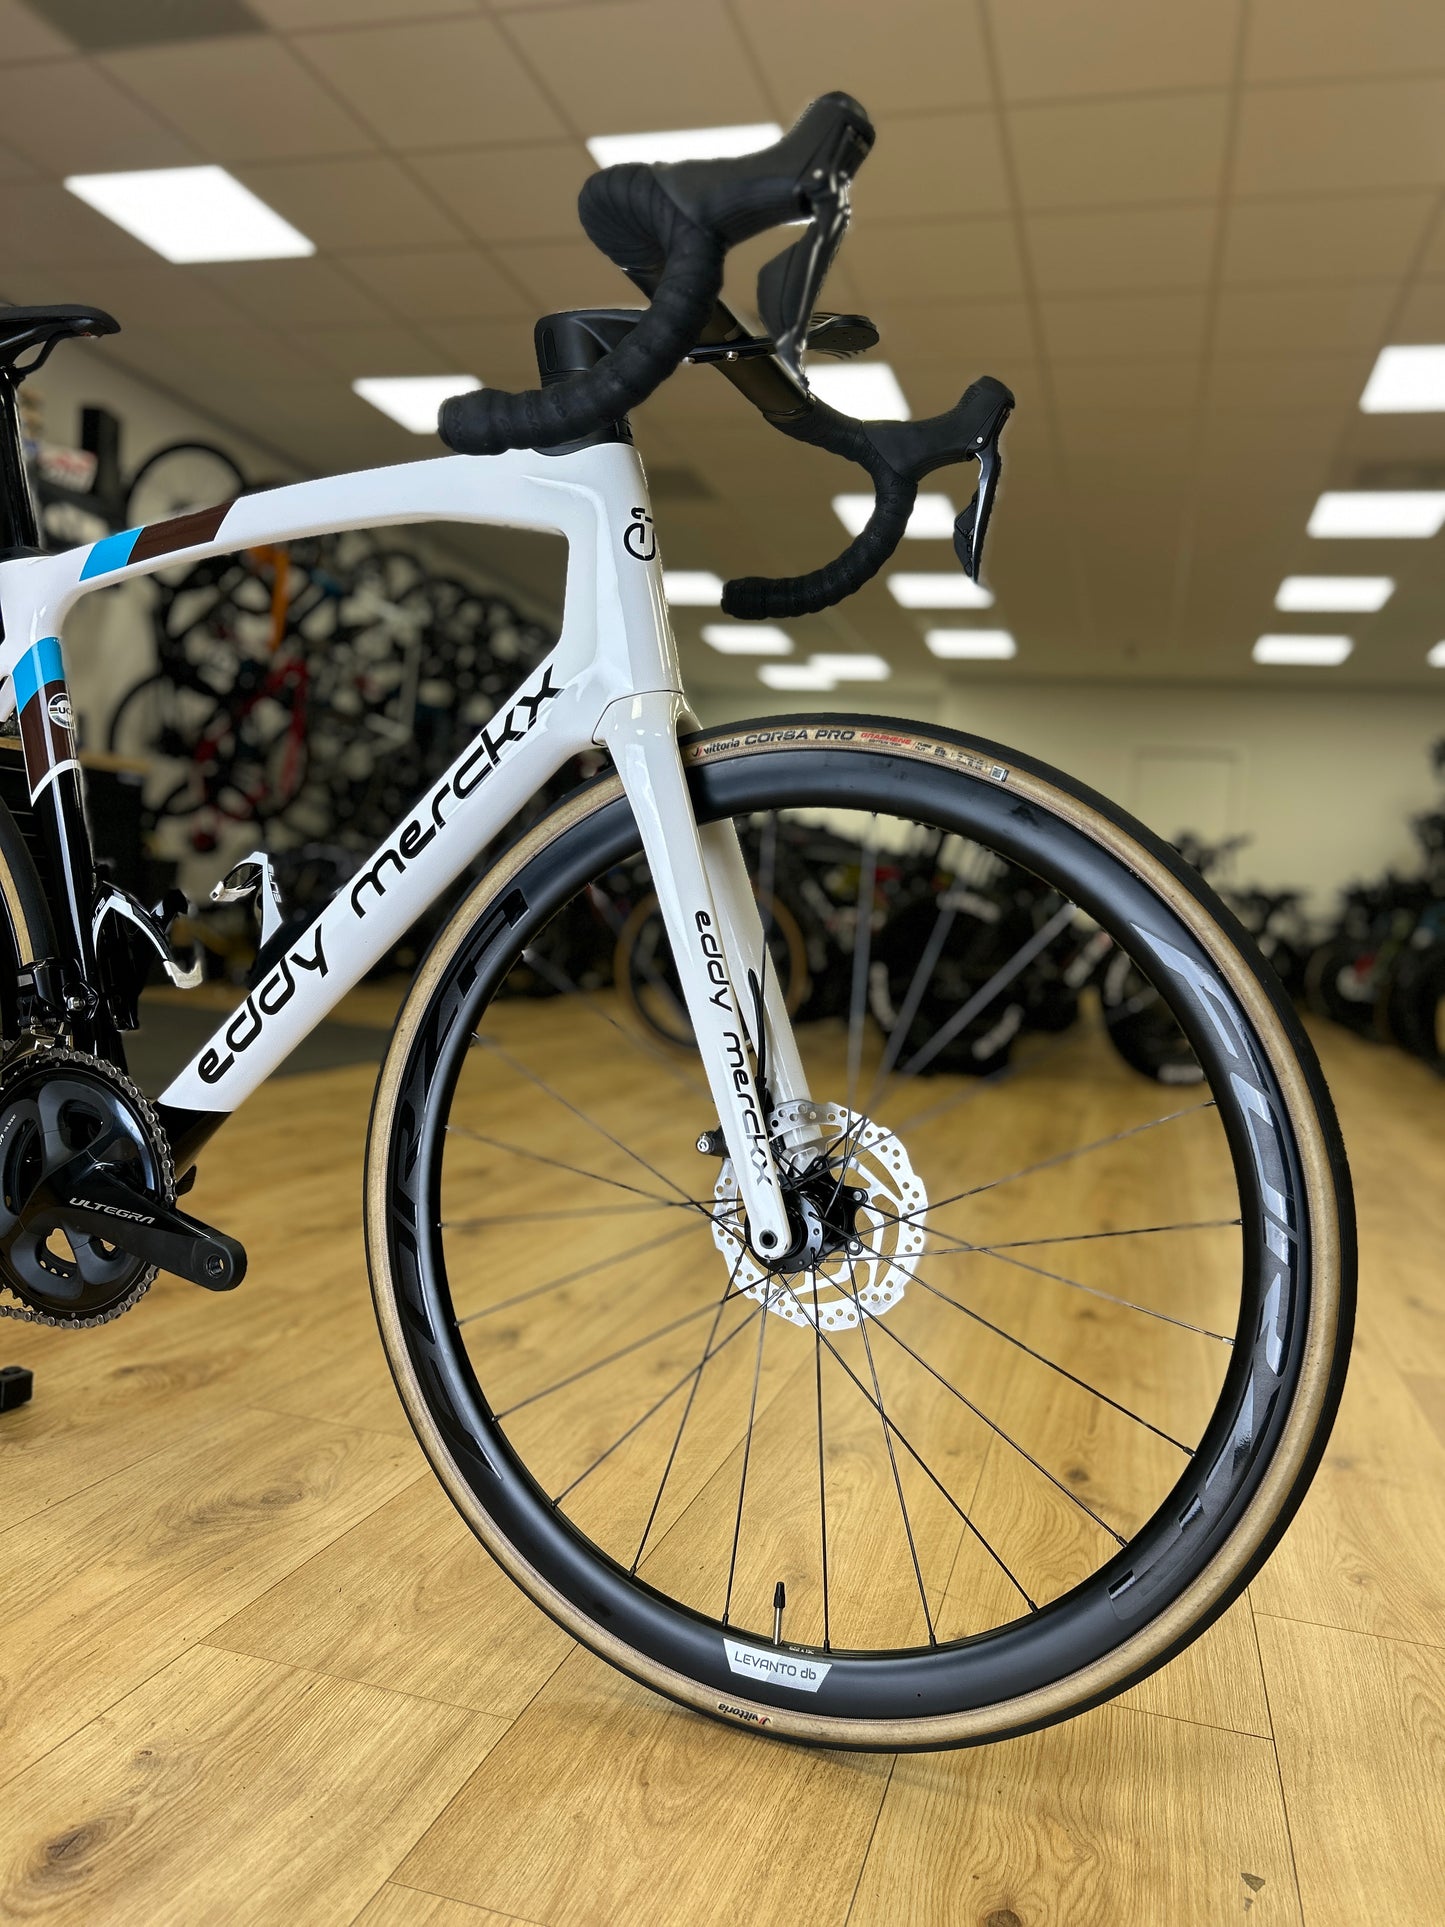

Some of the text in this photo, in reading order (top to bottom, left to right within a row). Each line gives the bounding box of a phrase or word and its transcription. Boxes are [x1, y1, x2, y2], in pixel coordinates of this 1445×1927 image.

[704, 730, 856, 753] vittoria CORSA PRO
[198, 663, 566, 1084] eddy merckx
[694, 909, 772, 1186] eddy merckx
[69, 1197, 156, 1225] ULTEGRA
[734, 1651, 817, 1680] LEVANTO db
[718, 1703, 759, 1722] vittoria
